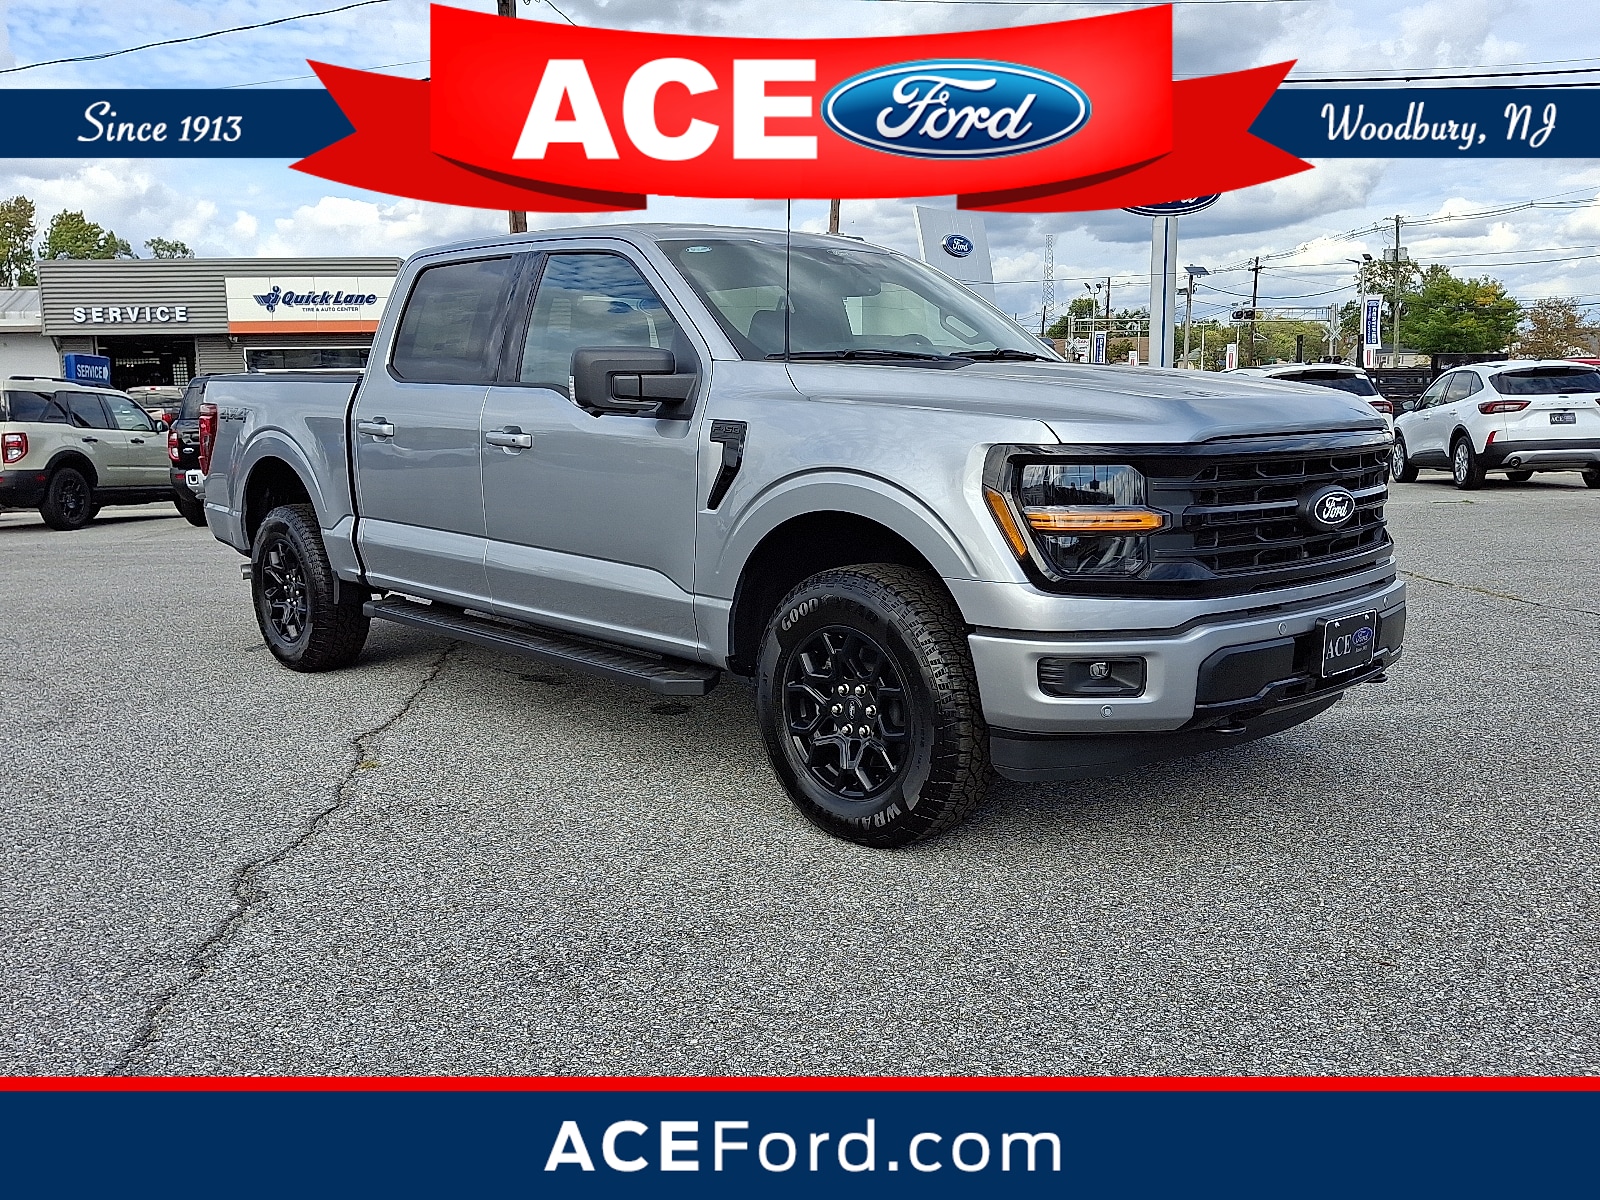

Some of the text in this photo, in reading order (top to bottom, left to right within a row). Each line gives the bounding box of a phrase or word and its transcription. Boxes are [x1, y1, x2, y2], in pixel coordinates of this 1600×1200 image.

[281, 290, 378, 307] Quick Lane
[73, 306, 188, 323] SERVICE
[76, 364, 103, 378] SERVICE
[1322, 496, 1349, 519] Ford
[1325, 634, 1352, 660] ACE
